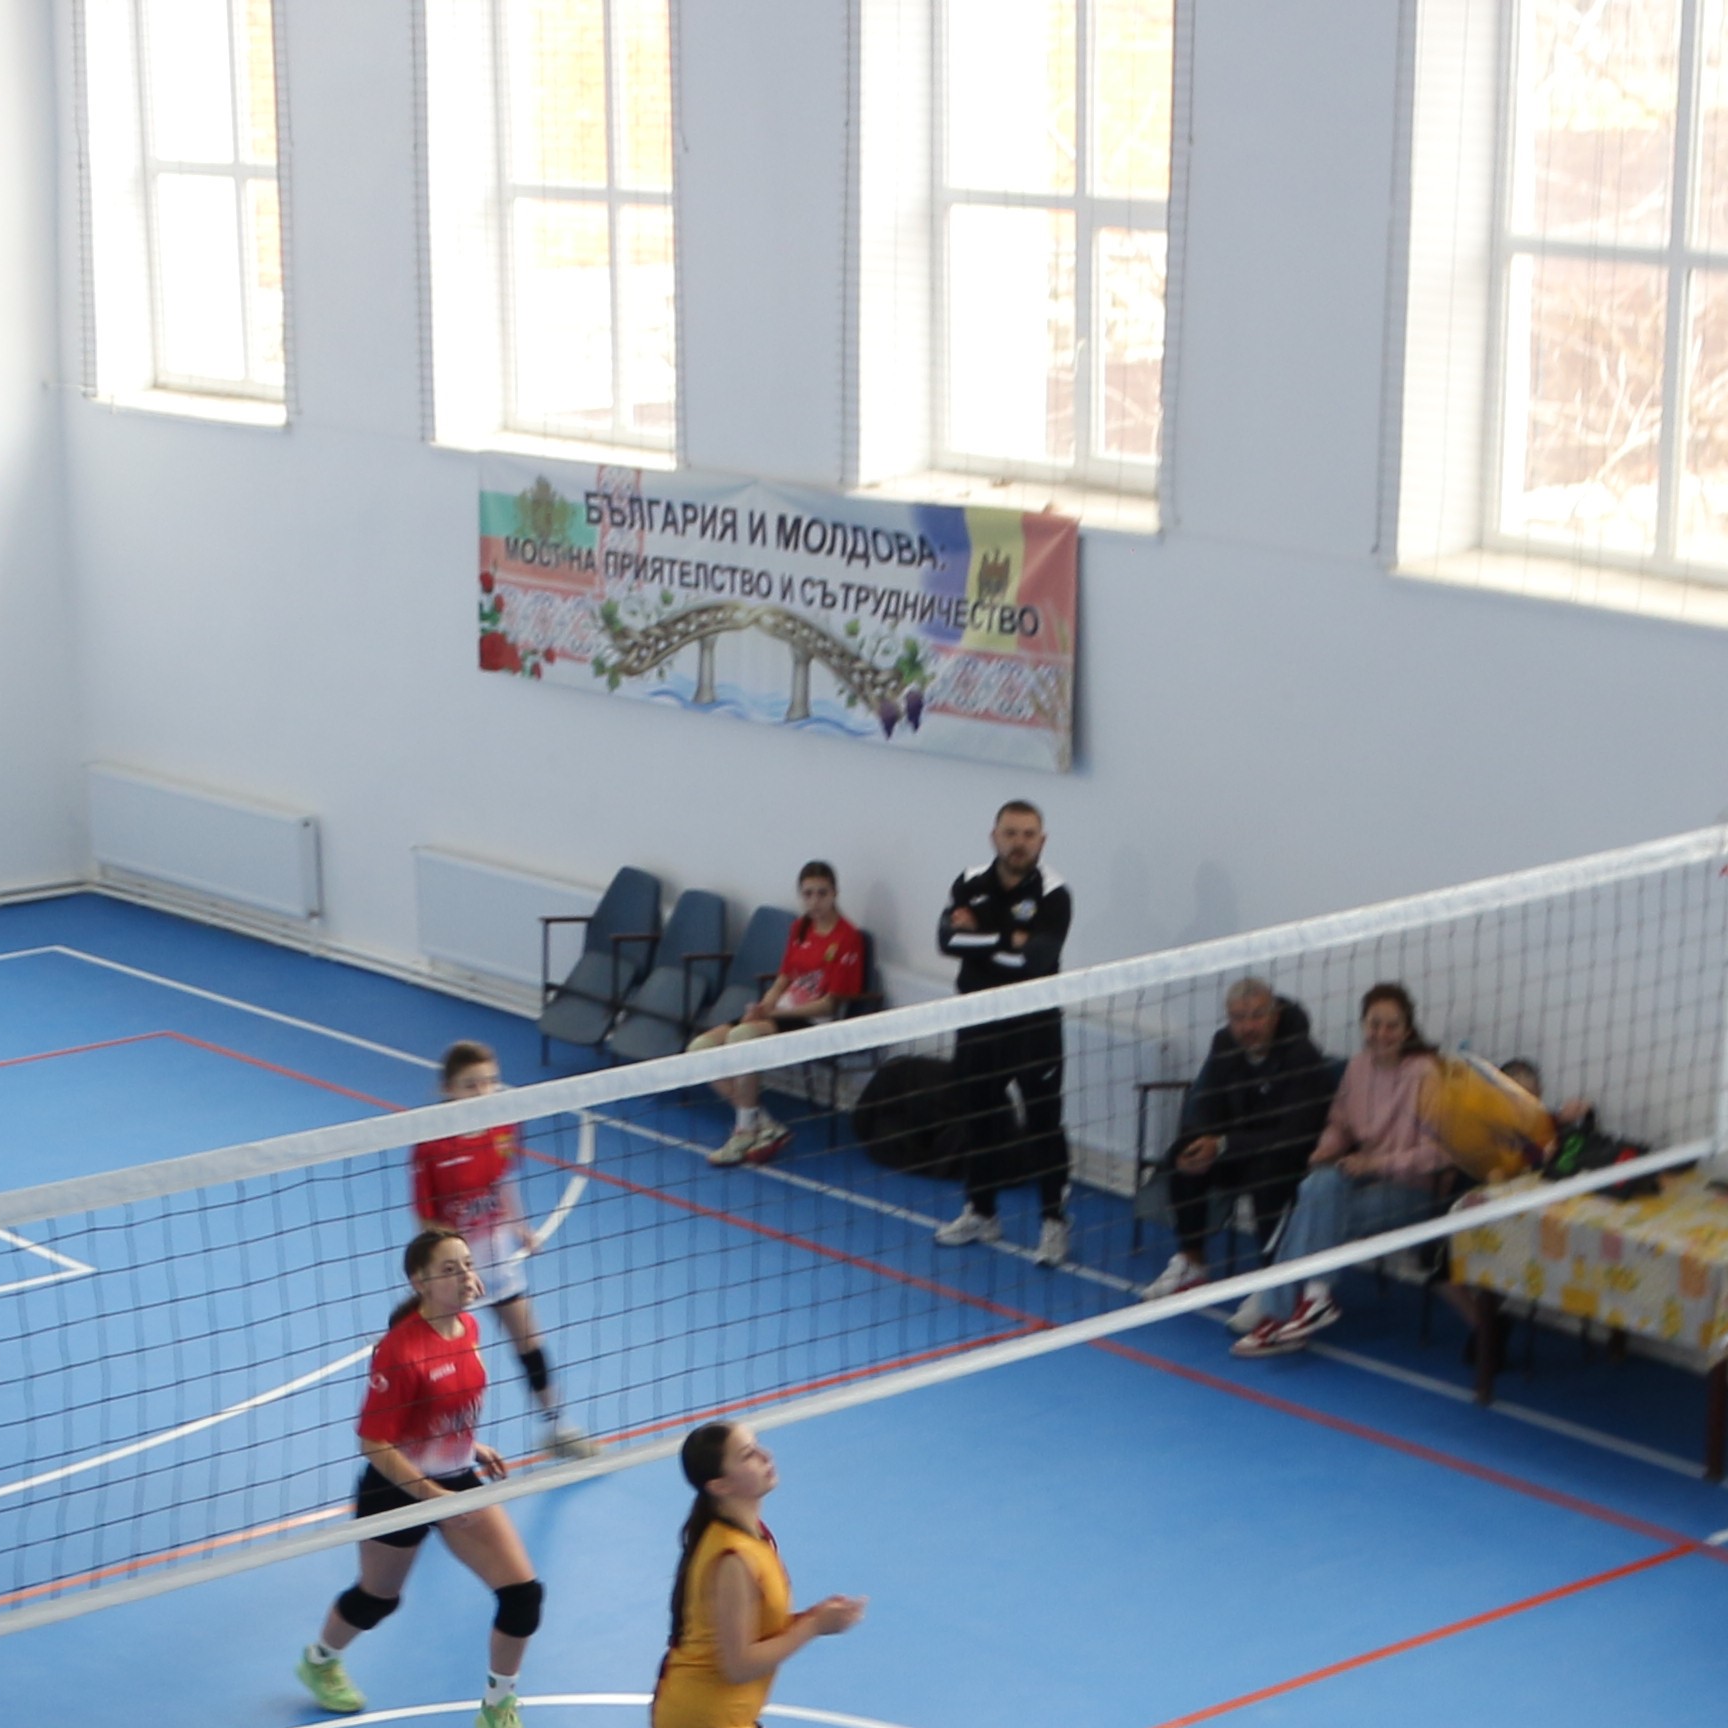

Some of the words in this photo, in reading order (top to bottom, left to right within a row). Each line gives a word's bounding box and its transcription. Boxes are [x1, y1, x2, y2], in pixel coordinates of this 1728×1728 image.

[584, 491, 738, 543] БЪЛГАРИЯ
[748, 509, 767, 547] И
[604, 550, 772, 600] ПРИЯТЕЛСТВО
[779, 575, 794, 601] И
[799, 576, 1040, 638] СЪТРУДНИЧЕСТВО
